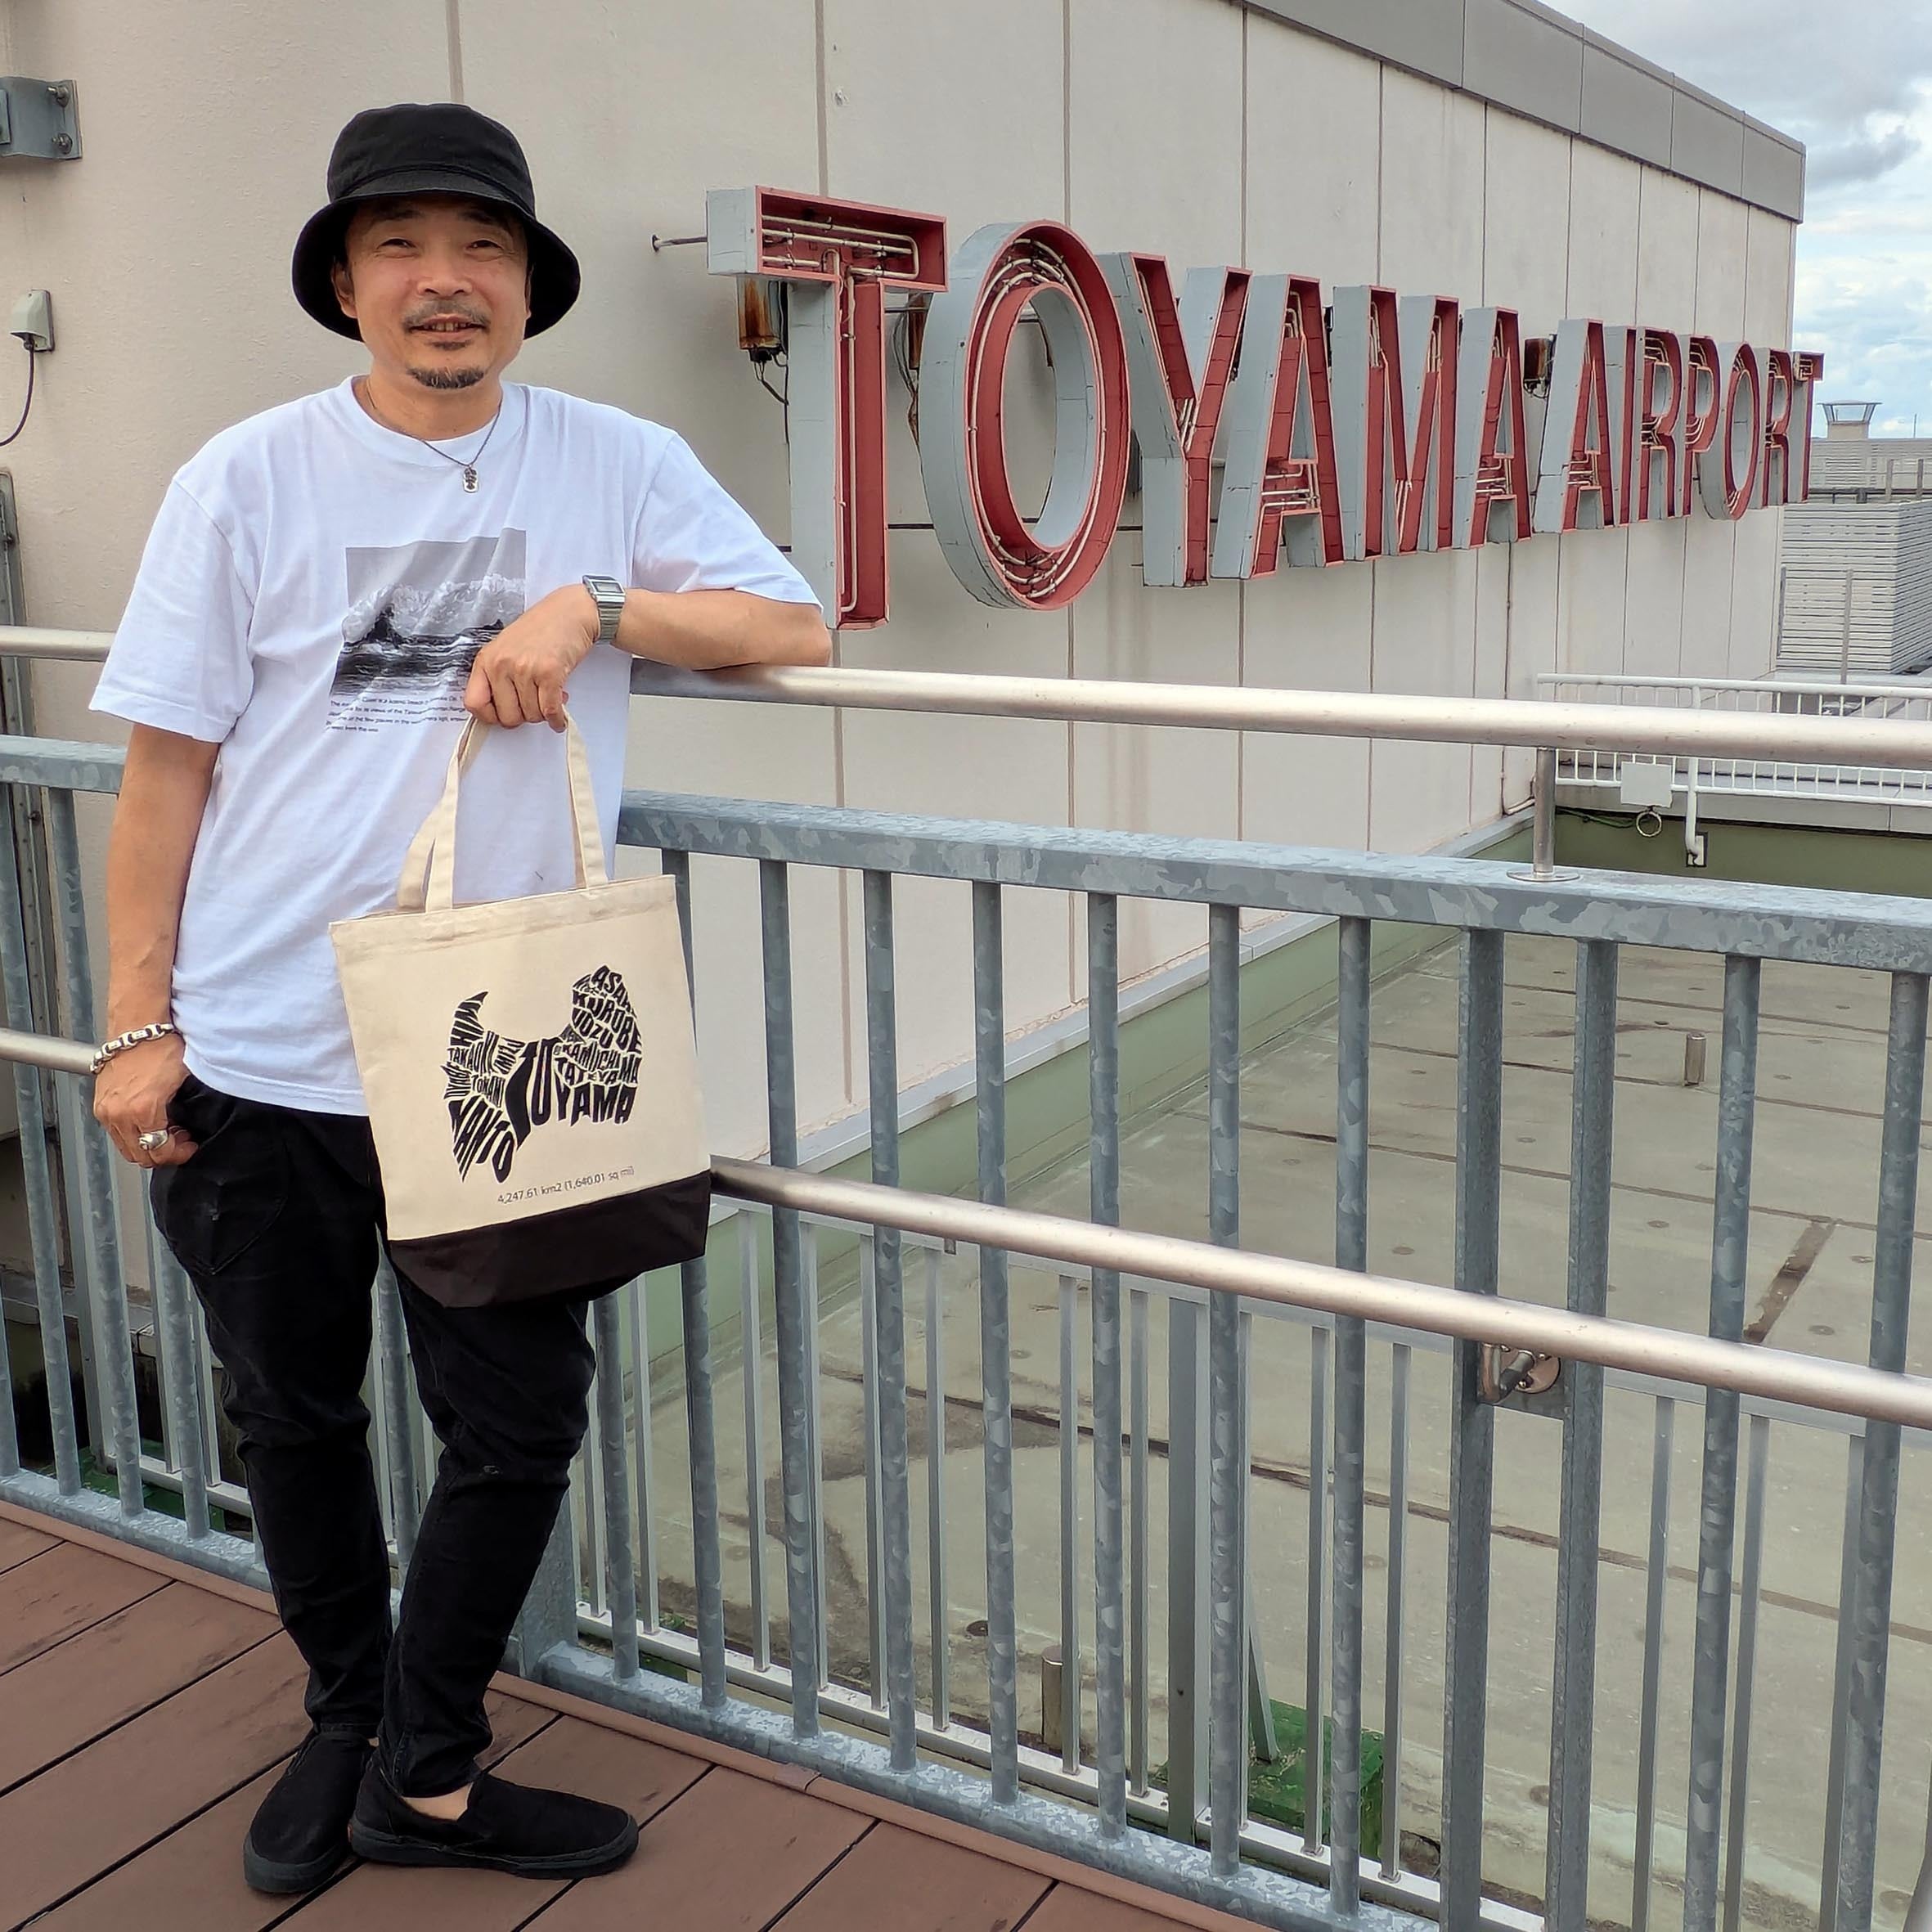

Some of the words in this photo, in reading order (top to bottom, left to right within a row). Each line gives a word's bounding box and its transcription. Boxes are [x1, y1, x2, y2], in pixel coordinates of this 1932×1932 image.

[708, 185, 1531, 630] TOYAMA
[1534, 317, 1825, 535] AIRPORT
[573, 990, 642, 1054] KUROBE
[573, 1008, 613, 1049] UOZU
[505, 1038, 637, 1150] TOYAMA
[449, 1096, 514, 1184] NANTO
[497, 1188, 538, 1204] 4,247.61
[541, 1183, 562, 1195] km2
